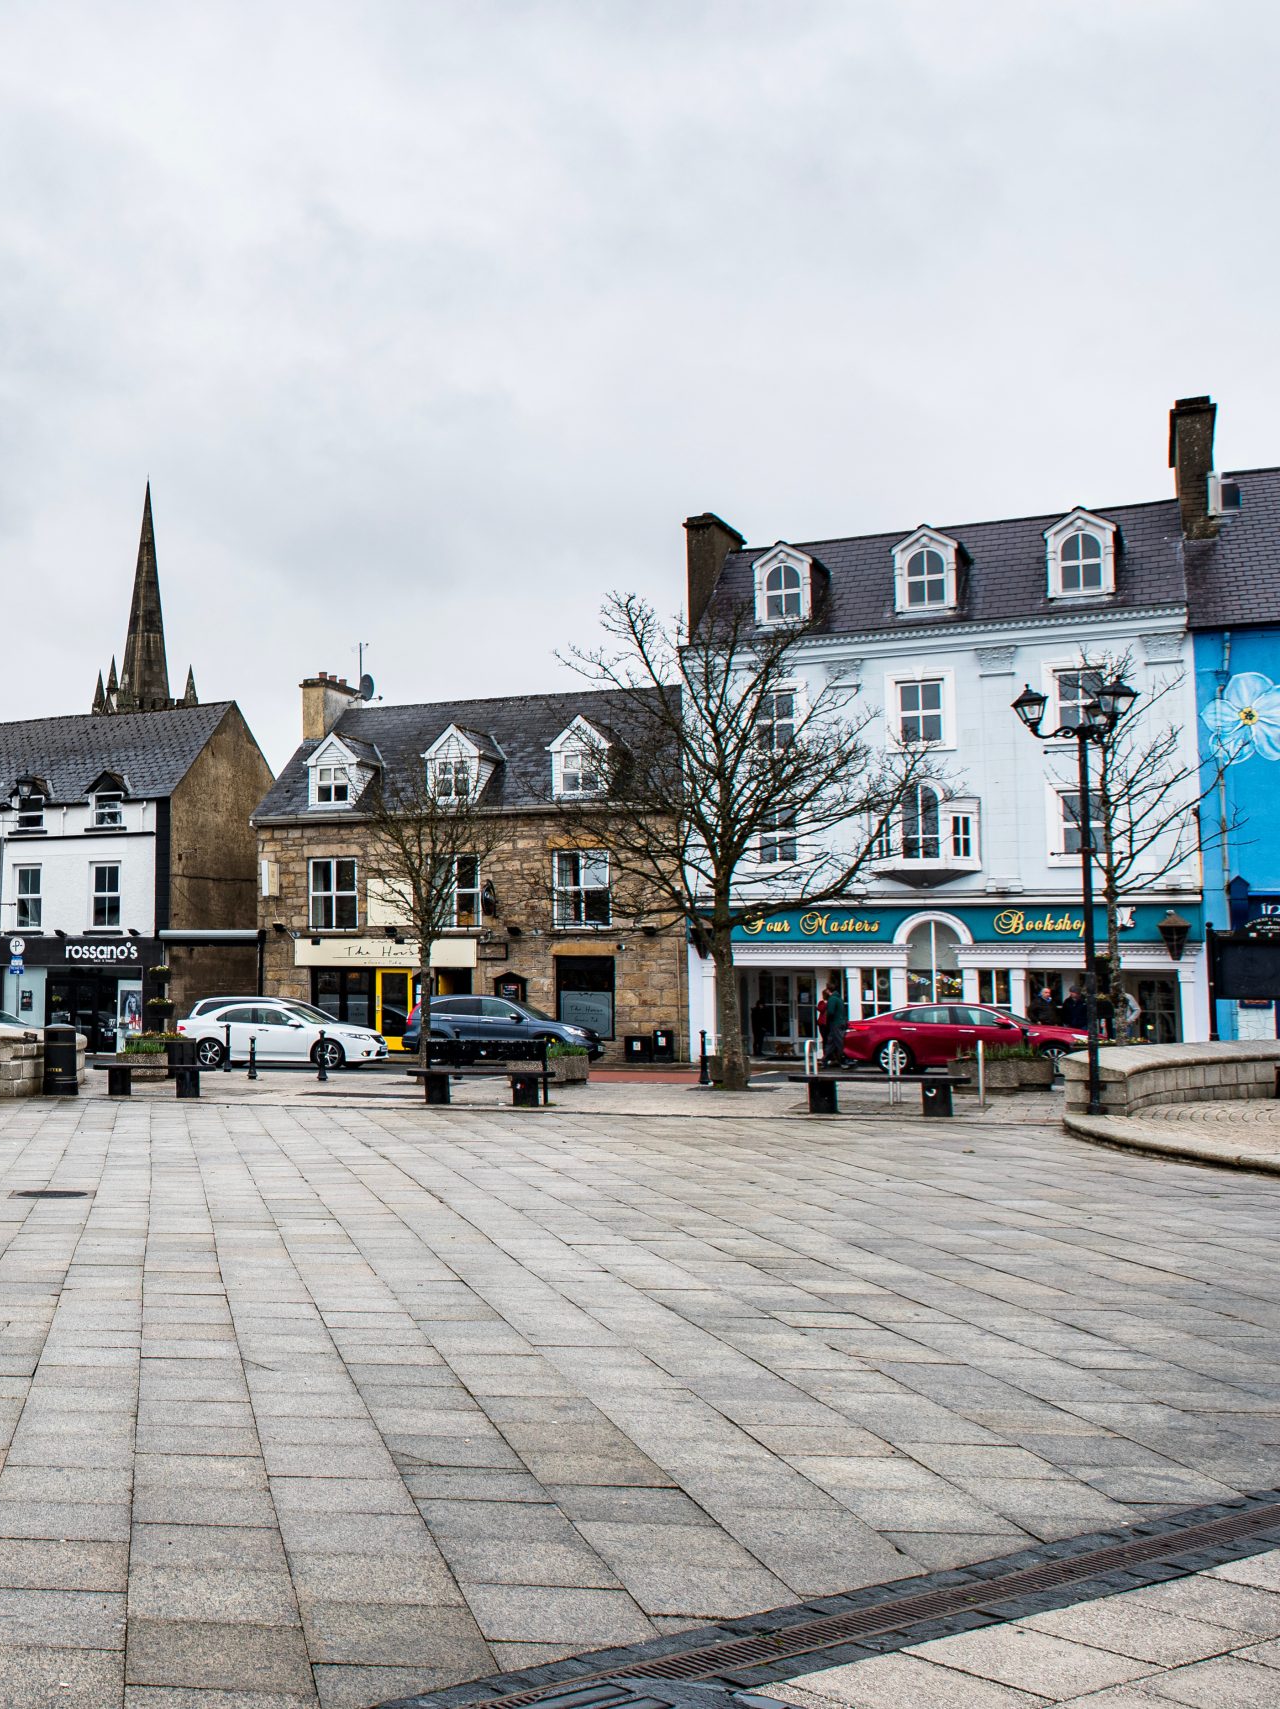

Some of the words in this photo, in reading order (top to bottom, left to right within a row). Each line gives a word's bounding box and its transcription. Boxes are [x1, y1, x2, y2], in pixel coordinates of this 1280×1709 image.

[742, 911, 791, 935] Four
[799, 911, 880, 935] Masters
[343, 945, 371, 957] The
